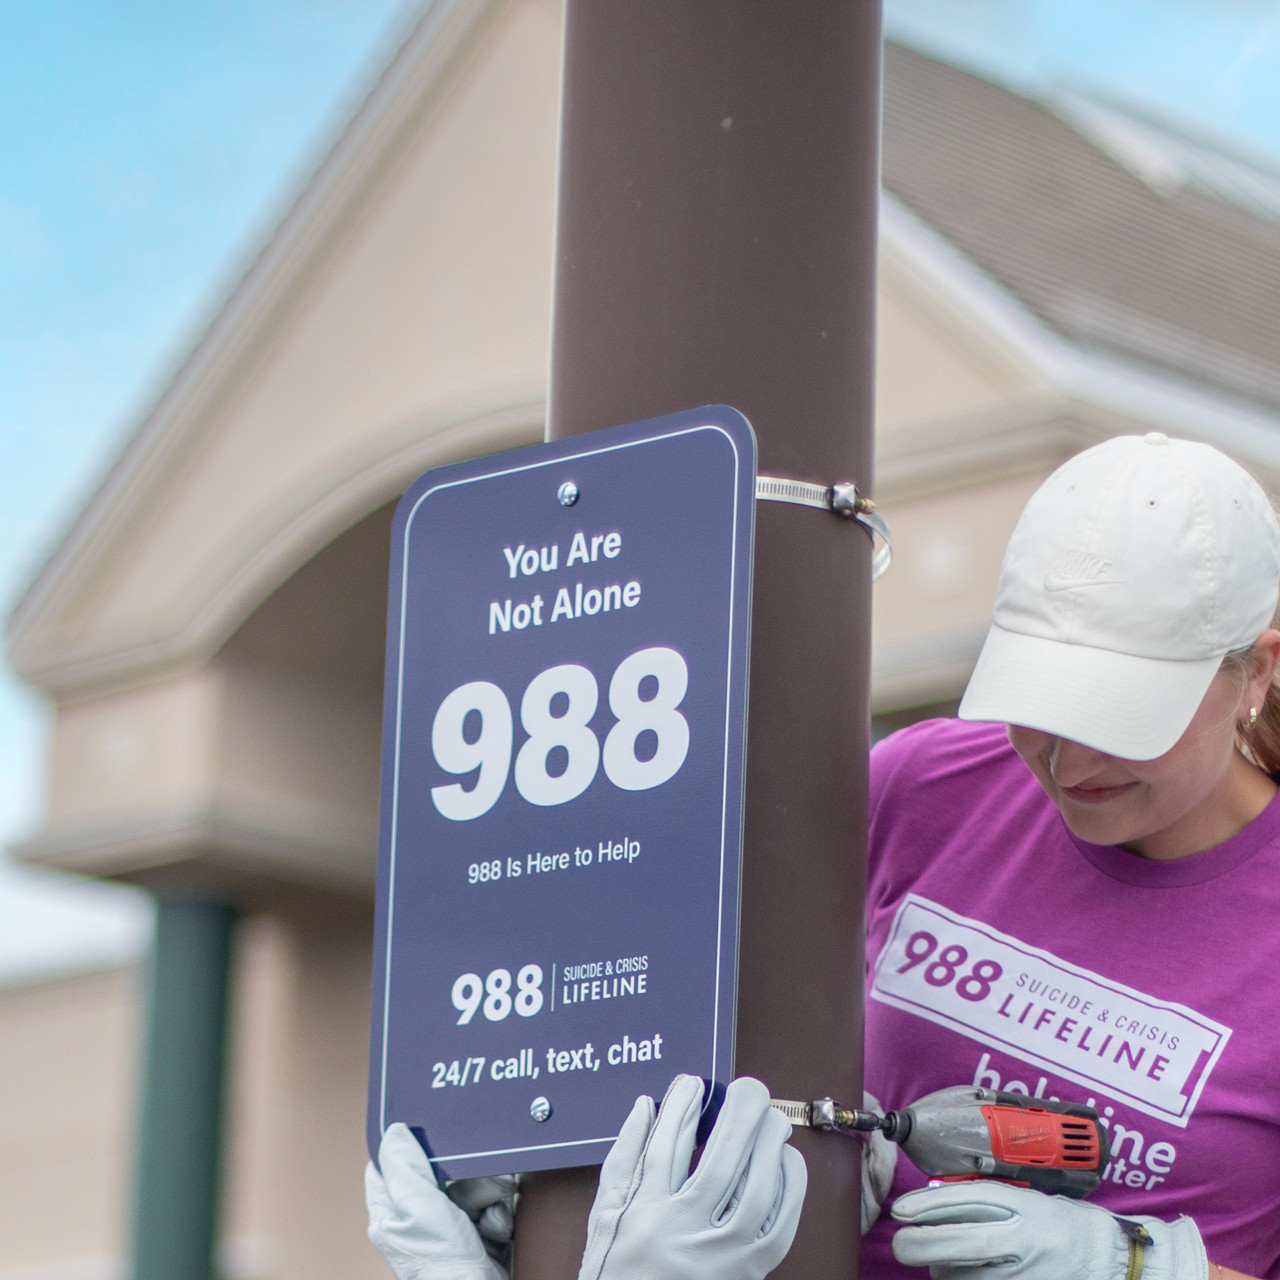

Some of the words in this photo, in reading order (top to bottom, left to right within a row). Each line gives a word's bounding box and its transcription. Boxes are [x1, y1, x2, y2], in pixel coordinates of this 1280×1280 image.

[503, 545, 558, 578] You
[567, 532, 621, 566] Are
[489, 595, 543, 634] Not
[551, 581, 641, 622] Alone
[431, 647, 689, 821] 988
[468, 860, 502, 884] 988
[506, 857, 521, 878] Is
[526, 851, 569, 875] Here
[574, 847, 593, 866] to
[598, 837, 641, 863] Help
[563, 961, 603, 981] SUICIDE
[605, 960, 613, 976] &
[615, 956, 648, 974] CRISIS
[563, 975, 647, 1004] LIFELINE
[896, 930, 1003, 1002] 988
[451, 964, 544, 1025] 988
[1016, 973, 1094, 1015] SUICIDE
[1097, 1008, 1110, 1023] &
[1115, 1015, 1181, 1051] CRISIS
[431, 1057, 486, 1088] 24/7
[490, 1049, 540, 1081] call,
[546, 1043, 601, 1072] text,
[607, 1034, 663, 1065] chat
[997, 993, 1170, 1081] LIFELINE
